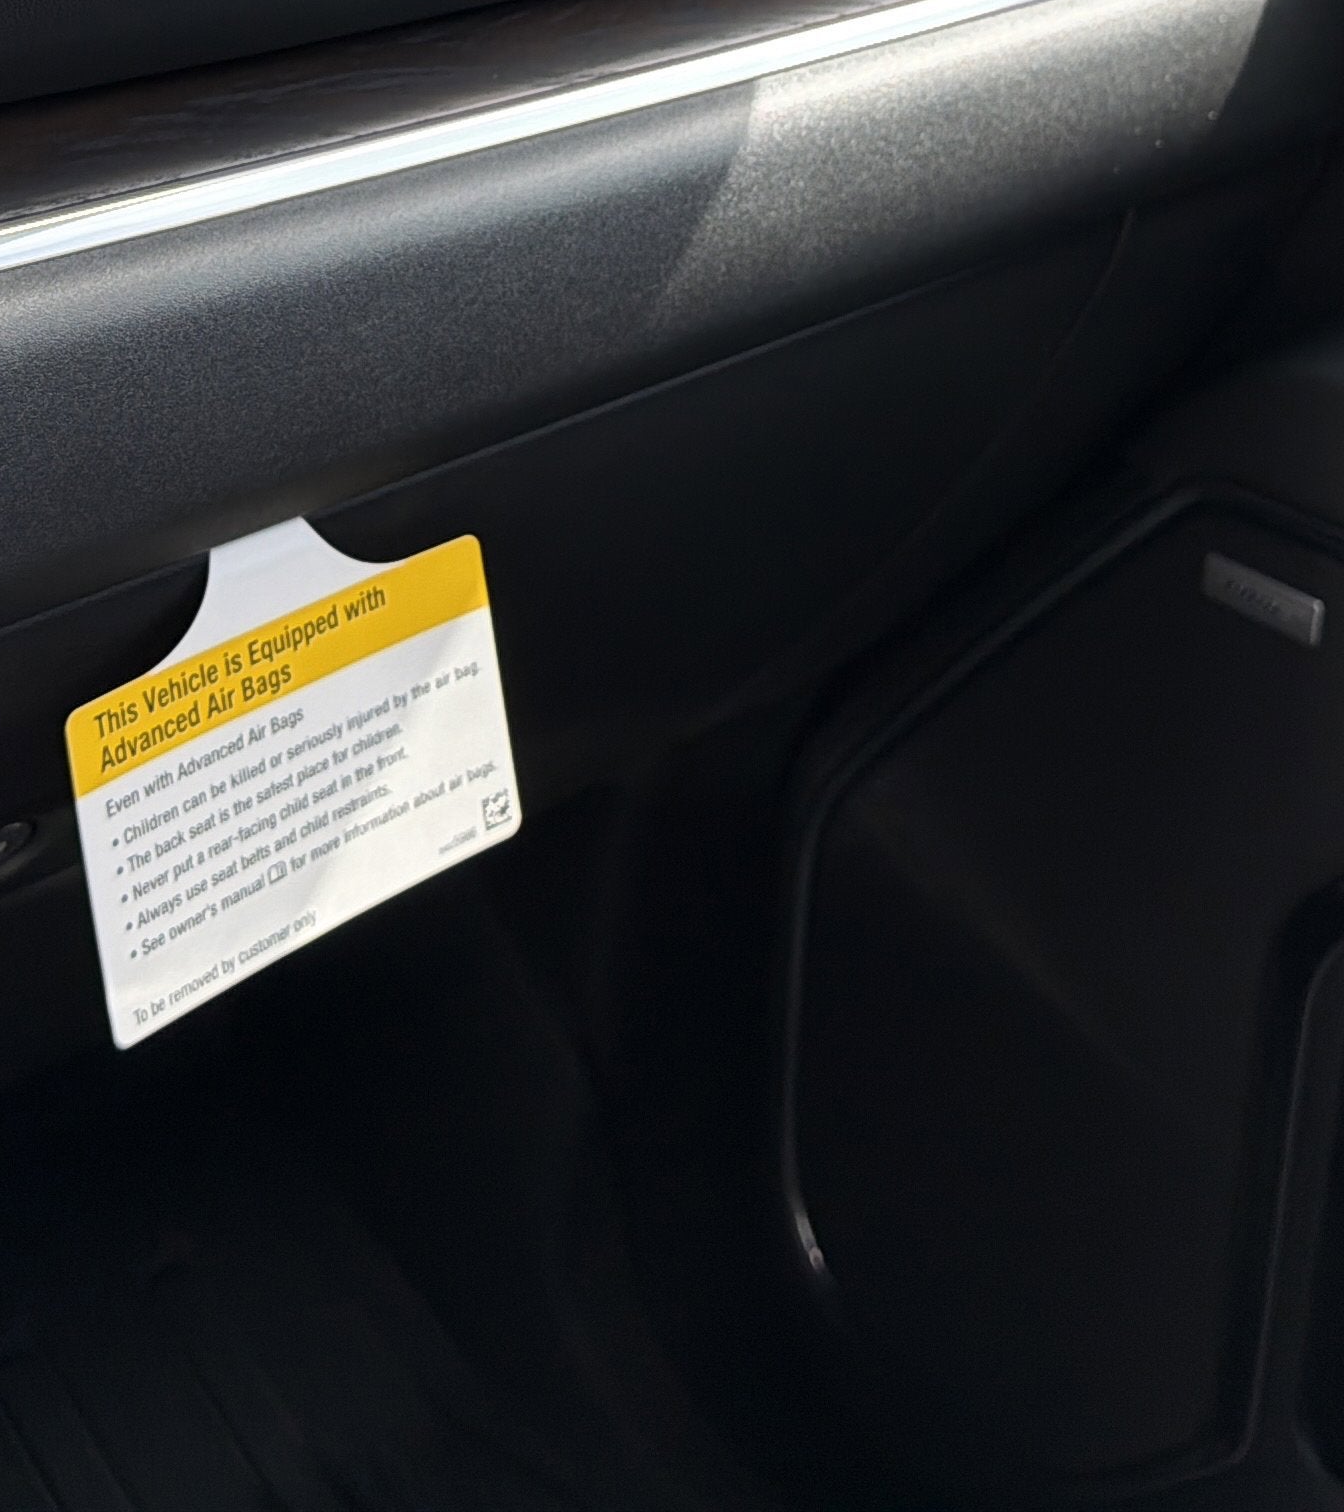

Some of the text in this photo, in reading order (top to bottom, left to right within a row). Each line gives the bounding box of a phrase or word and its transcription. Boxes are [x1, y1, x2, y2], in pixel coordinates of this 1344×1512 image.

[94, 585, 386, 738] This Vehicle is Equipped with
[101, 664, 292, 773] Advanced Air Bags
[105, 708, 304, 818] Even with Advanced Air Bags
[124, 806, 179, 844] Children
[183, 792, 206, 813] can
[211, 780, 226, 798] be
[231, 759, 266, 788] killed
[270, 752, 283, 768] or
[287, 722, 343, 760] seriously
[347, 698, 390, 731] injured
[393, 693, 407, 708] by
[411, 681, 431, 700] the
[435, 674, 449, 689] air
[127, 850, 152, 872] The
[154, 830, 186, 857] back
[188, 813, 216, 840] seat
[219, 808, 230, 823] is
[233, 796, 253, 816] the
[257, 774, 294, 804] safest
[297, 758, 329, 786] place
[332, 748, 349, 765] for
[132, 869, 169, 900] Never
[173, 855, 194, 882] put
[197, 851, 205, 864] a
[208, 813, 277, 859] rear-facing
[279, 794, 309, 820] child
[312, 780, 339, 804] seat
[341, 774, 352, 789] in
[355, 763, 374, 781] the
[137, 893, 183, 929] Always
[186, 879, 208, 900] use
[211, 860, 238, 886] seat
[241, 844, 271, 870] belts
[274, 829, 297, 852] and
[300, 811, 329, 838] child
[141, 934, 166, 955] See
[169, 903, 218, 940] owner's
[221, 874, 265, 911] manual
[290, 854, 306, 872] for
[311, 837, 341, 861] more
[345, 801, 410, 843] information
[414, 782, 445, 808] about
[449, 776, 463, 791] air
[133, 909, 317, 1025] To be removed by customer only
